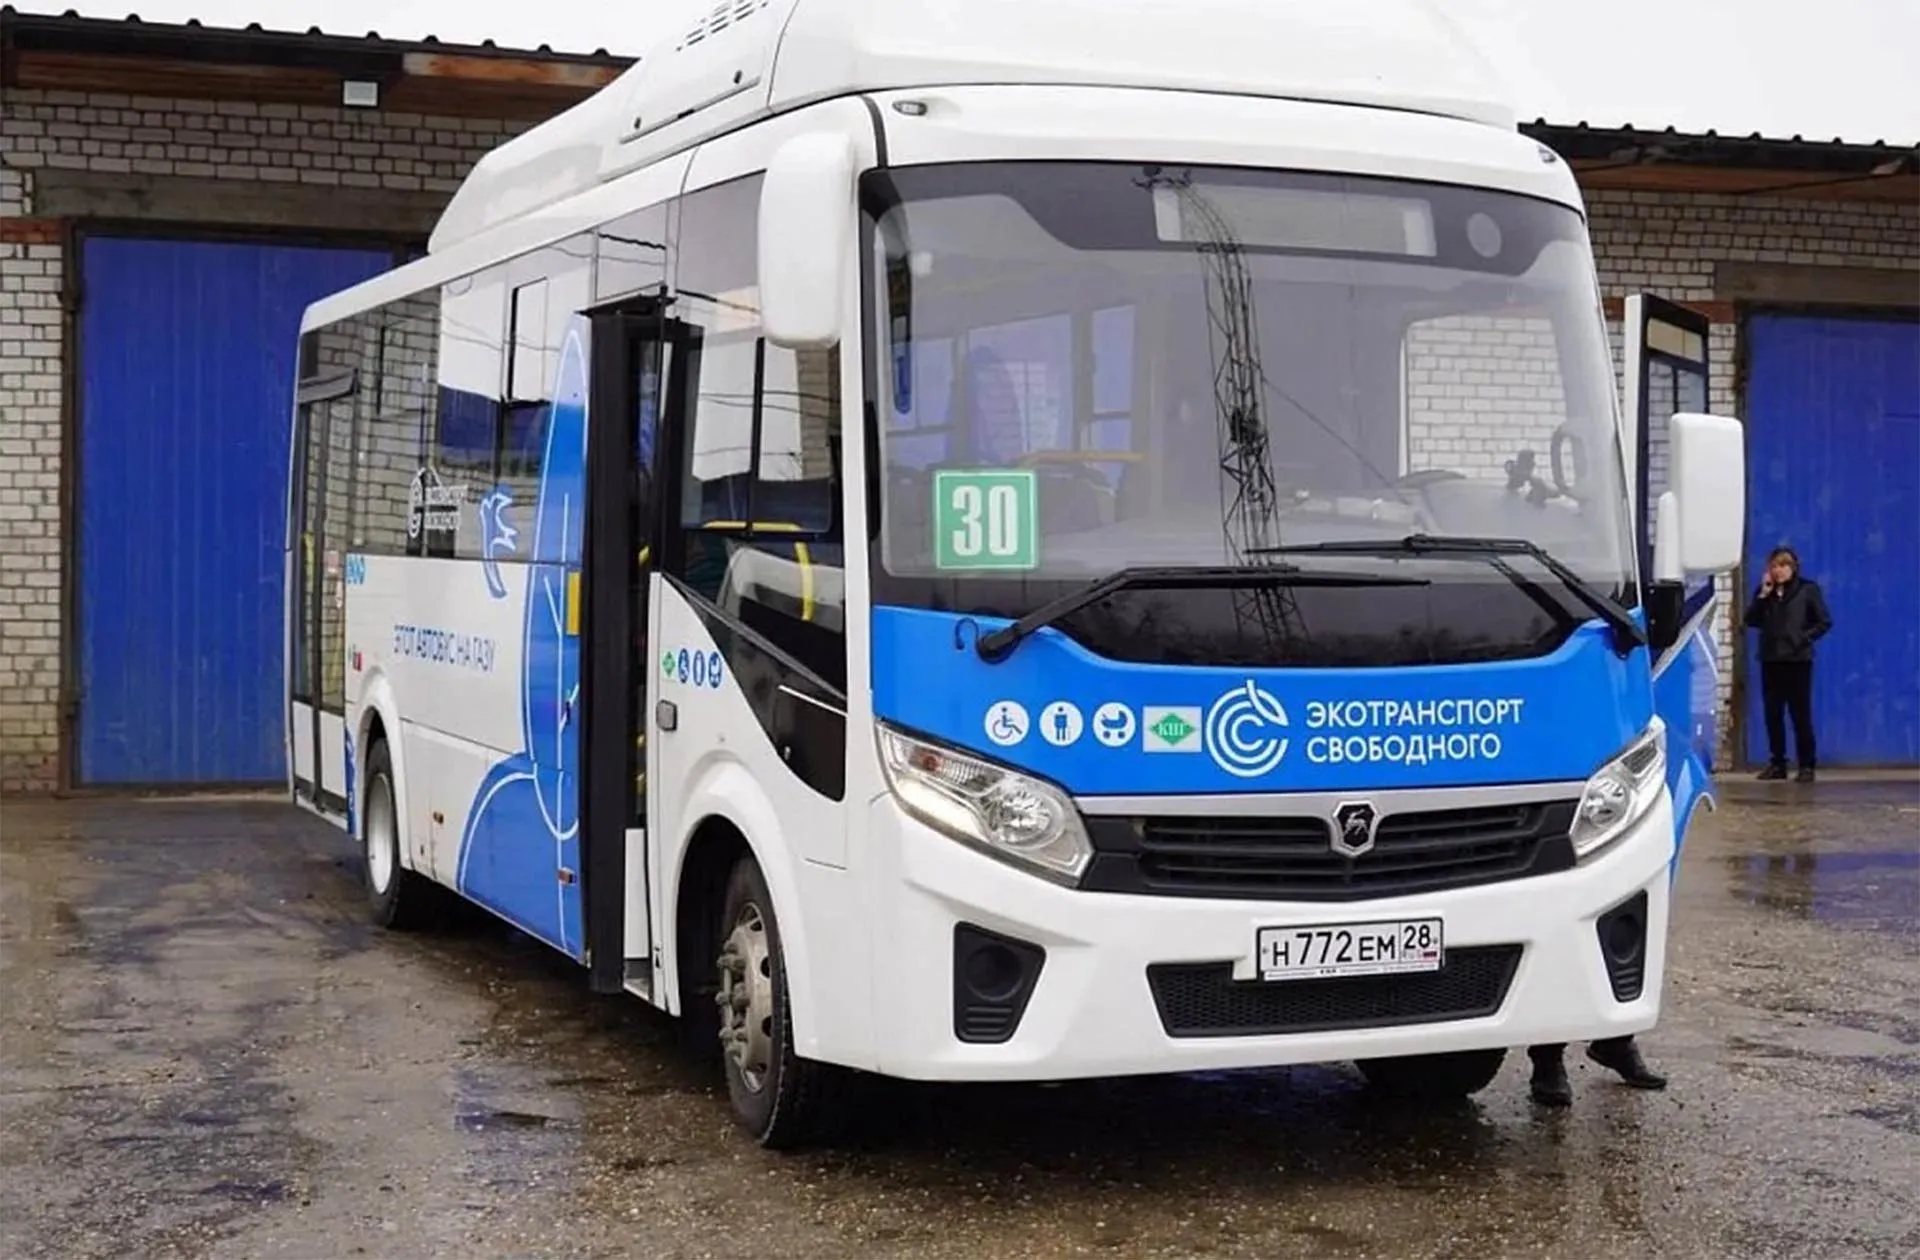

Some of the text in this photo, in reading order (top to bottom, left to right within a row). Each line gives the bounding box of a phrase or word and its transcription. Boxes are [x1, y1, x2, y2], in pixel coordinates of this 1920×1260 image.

[952, 485, 1018, 556] 30
[1306, 698, 1524, 728] ЭКОТРАНСПОРТ
[1307, 732, 1502, 766] СВОБОДНОГО
[1403, 924, 1431, 950] 28
